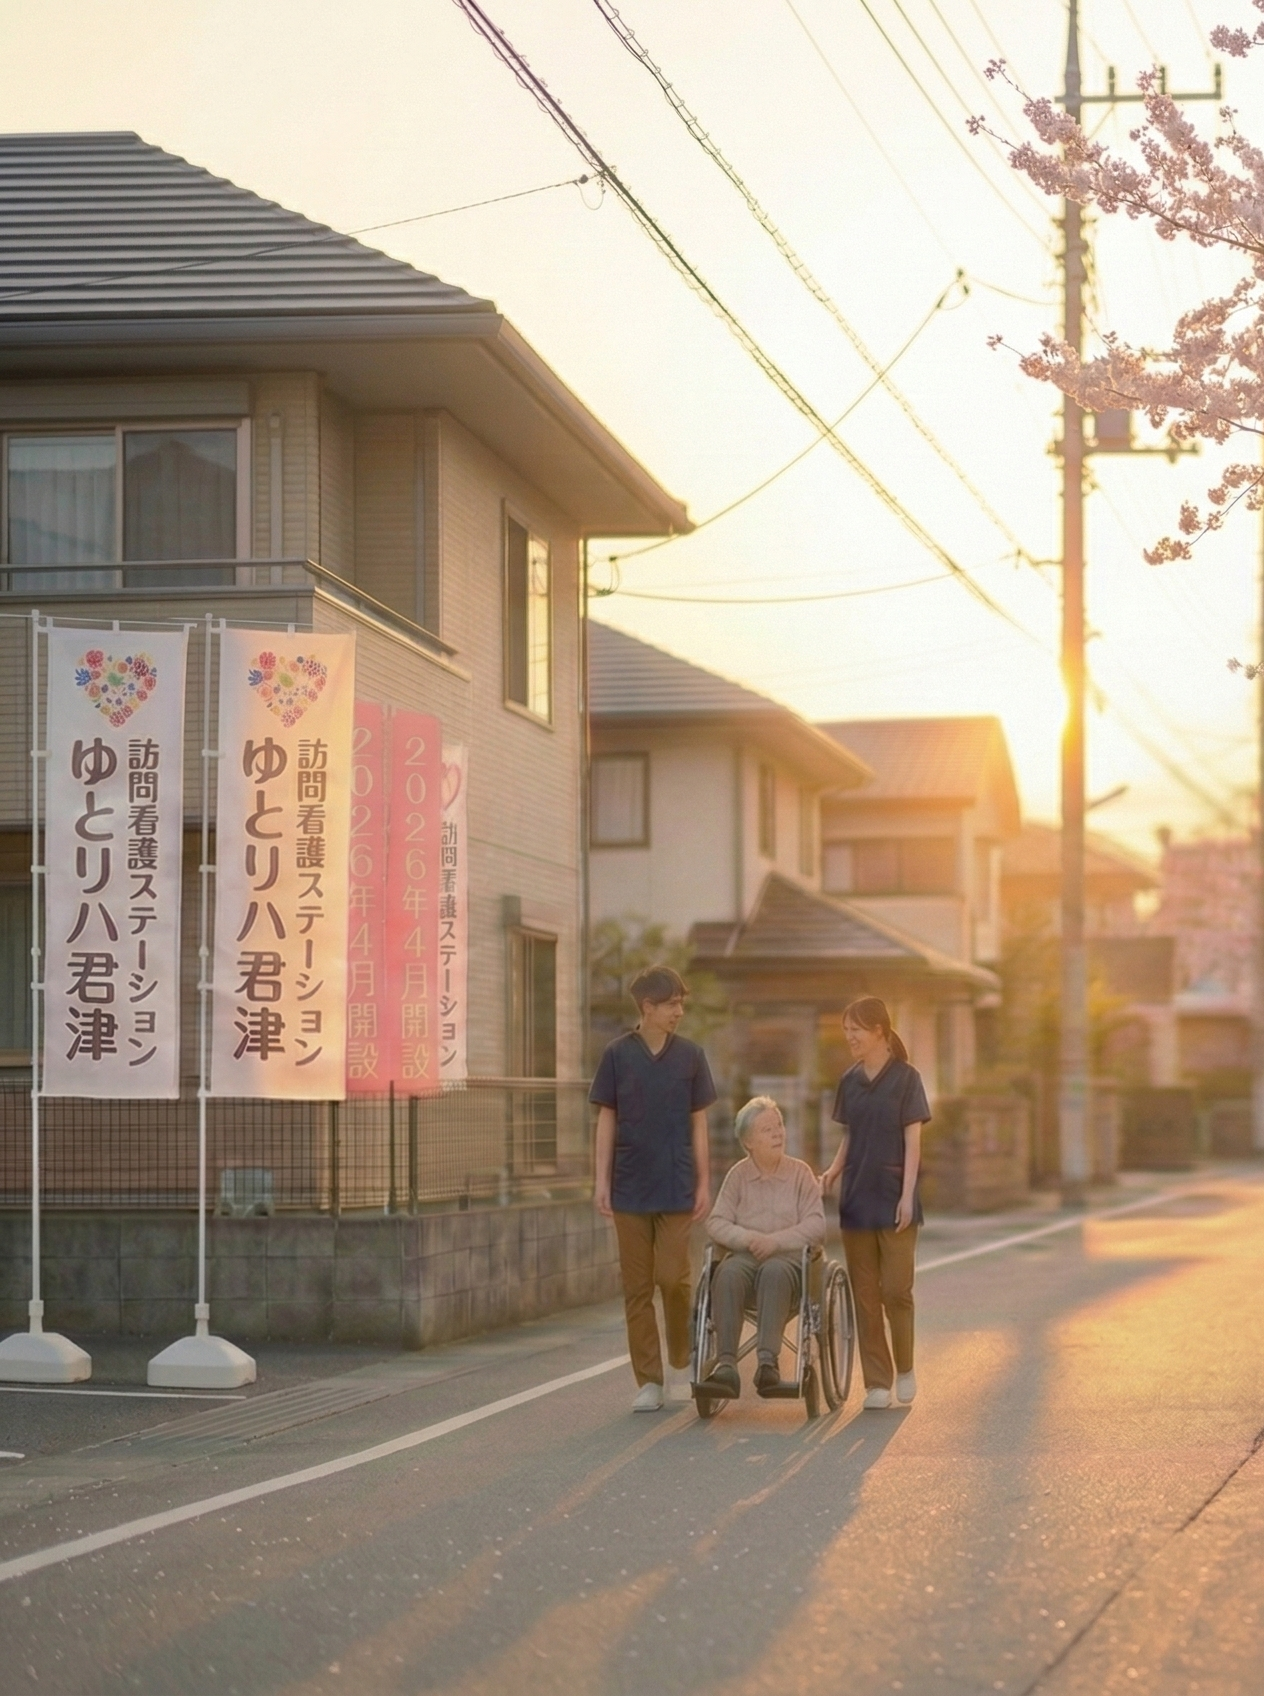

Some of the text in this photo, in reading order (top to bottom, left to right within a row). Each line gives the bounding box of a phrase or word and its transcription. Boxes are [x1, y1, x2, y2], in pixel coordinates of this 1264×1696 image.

[127, 738, 160, 1067] 訪問看護ステーション
[294, 738, 328, 1067] 訪問看護ステーション
[400, 736, 430, 1080] 2026年4月開設
